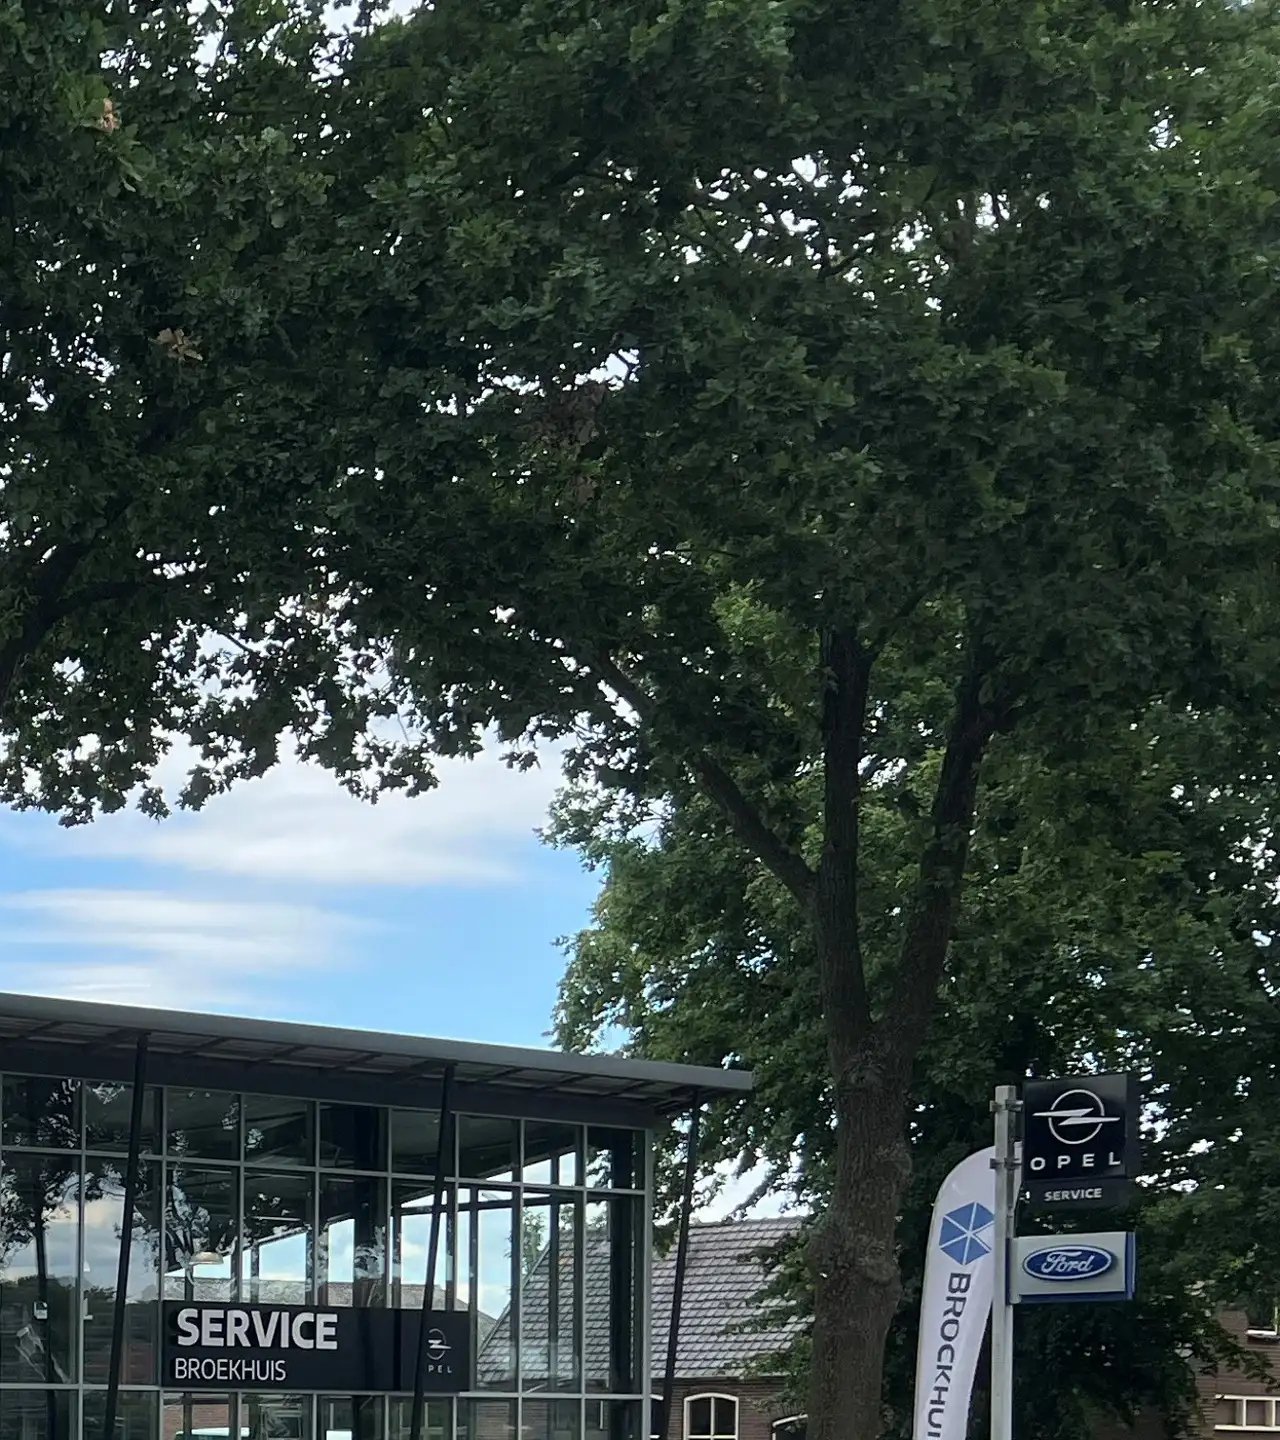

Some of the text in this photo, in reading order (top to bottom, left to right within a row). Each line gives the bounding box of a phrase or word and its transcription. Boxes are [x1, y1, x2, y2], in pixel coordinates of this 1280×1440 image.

[1030, 1151, 1122, 1172] OPEL
[1044, 1188, 1102, 1201] SERVICE
[1040, 1250, 1094, 1274] Ford
[176, 1307, 338, 1351] SERVICE
[174, 1357, 287, 1381] BROEKHUIS
[428, 1364, 453, 1374] PEL
